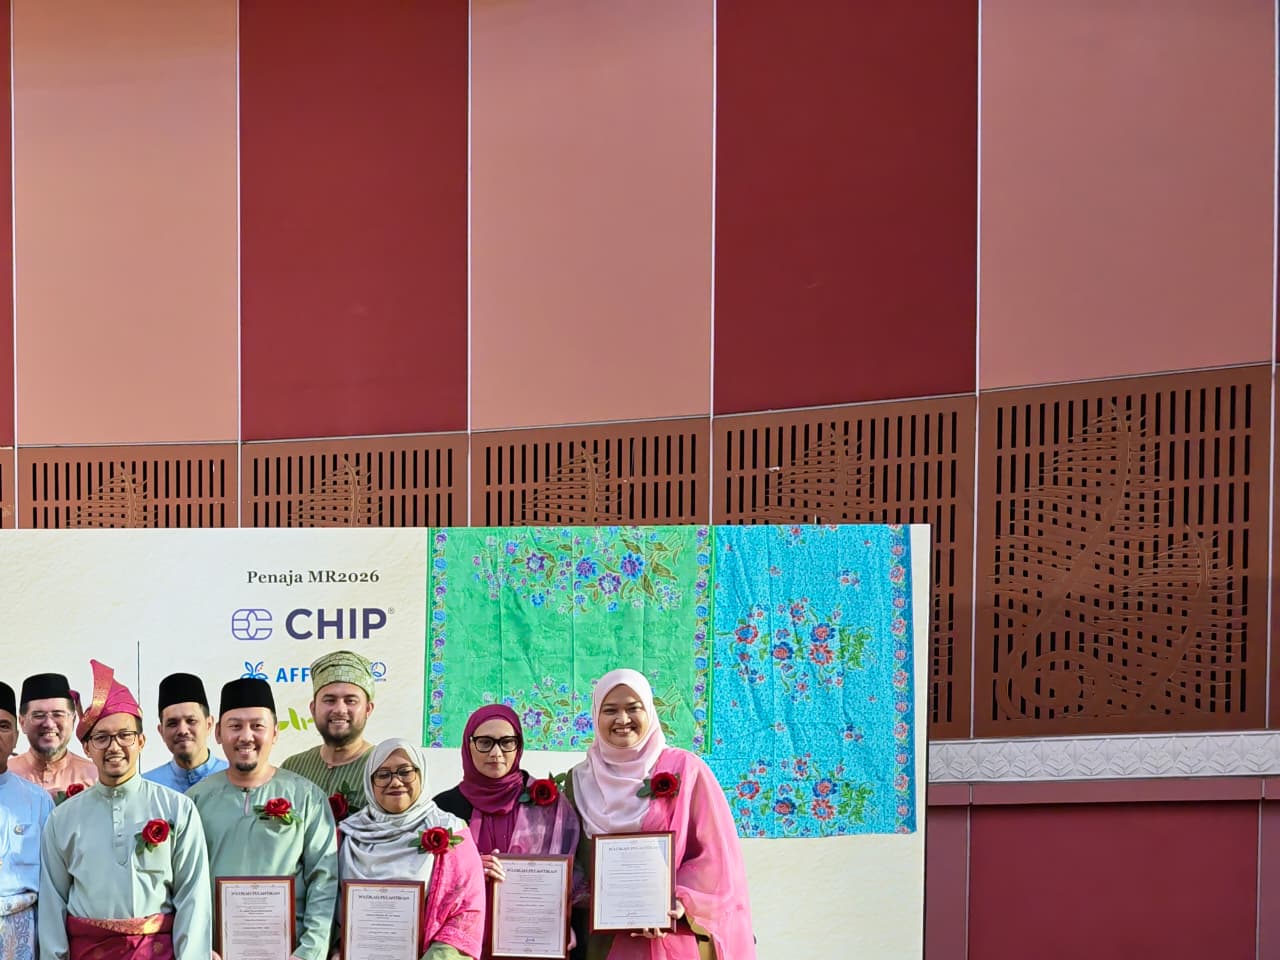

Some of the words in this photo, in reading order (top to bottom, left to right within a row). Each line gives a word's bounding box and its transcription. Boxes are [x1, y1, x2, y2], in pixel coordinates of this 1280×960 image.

[247, 570, 303, 586] Penaja
[308, 570, 380, 583] MR2026
[285, 608, 387, 640] CHIP
[276, 667, 310, 682] AFF
